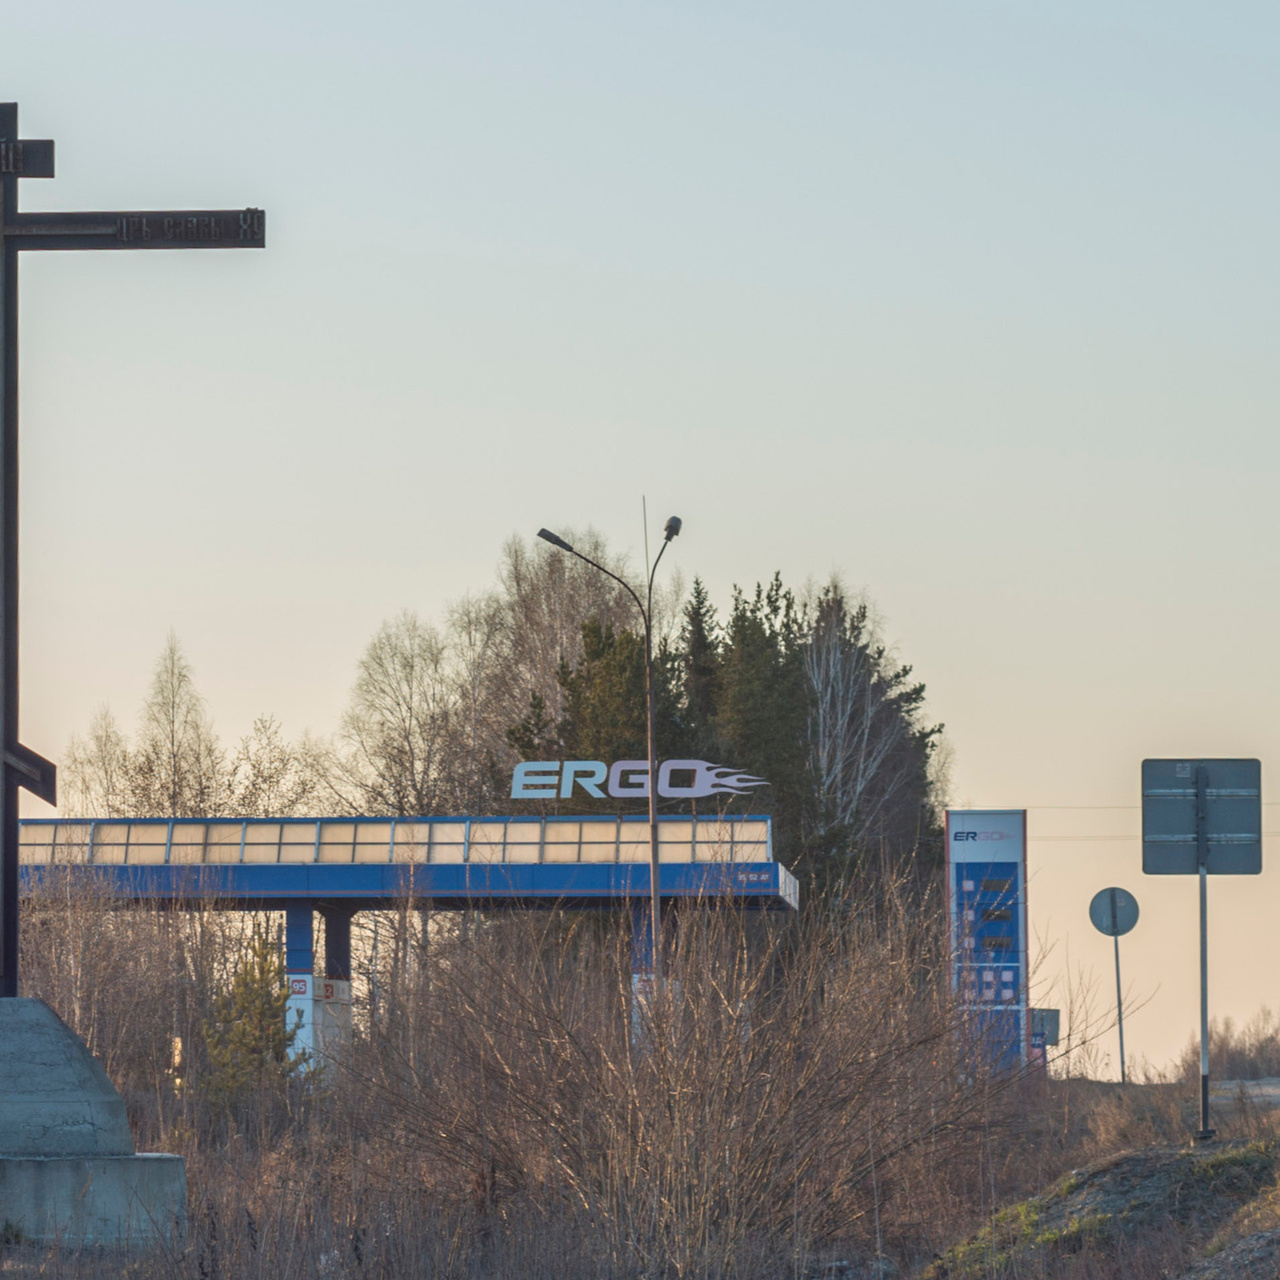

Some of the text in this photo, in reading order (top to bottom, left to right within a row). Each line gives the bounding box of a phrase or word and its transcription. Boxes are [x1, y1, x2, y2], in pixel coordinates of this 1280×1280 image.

[510, 758, 715, 799] ERGO
[953, 831, 1003, 841] ERGO
[292, 982, 306, 992] 95
